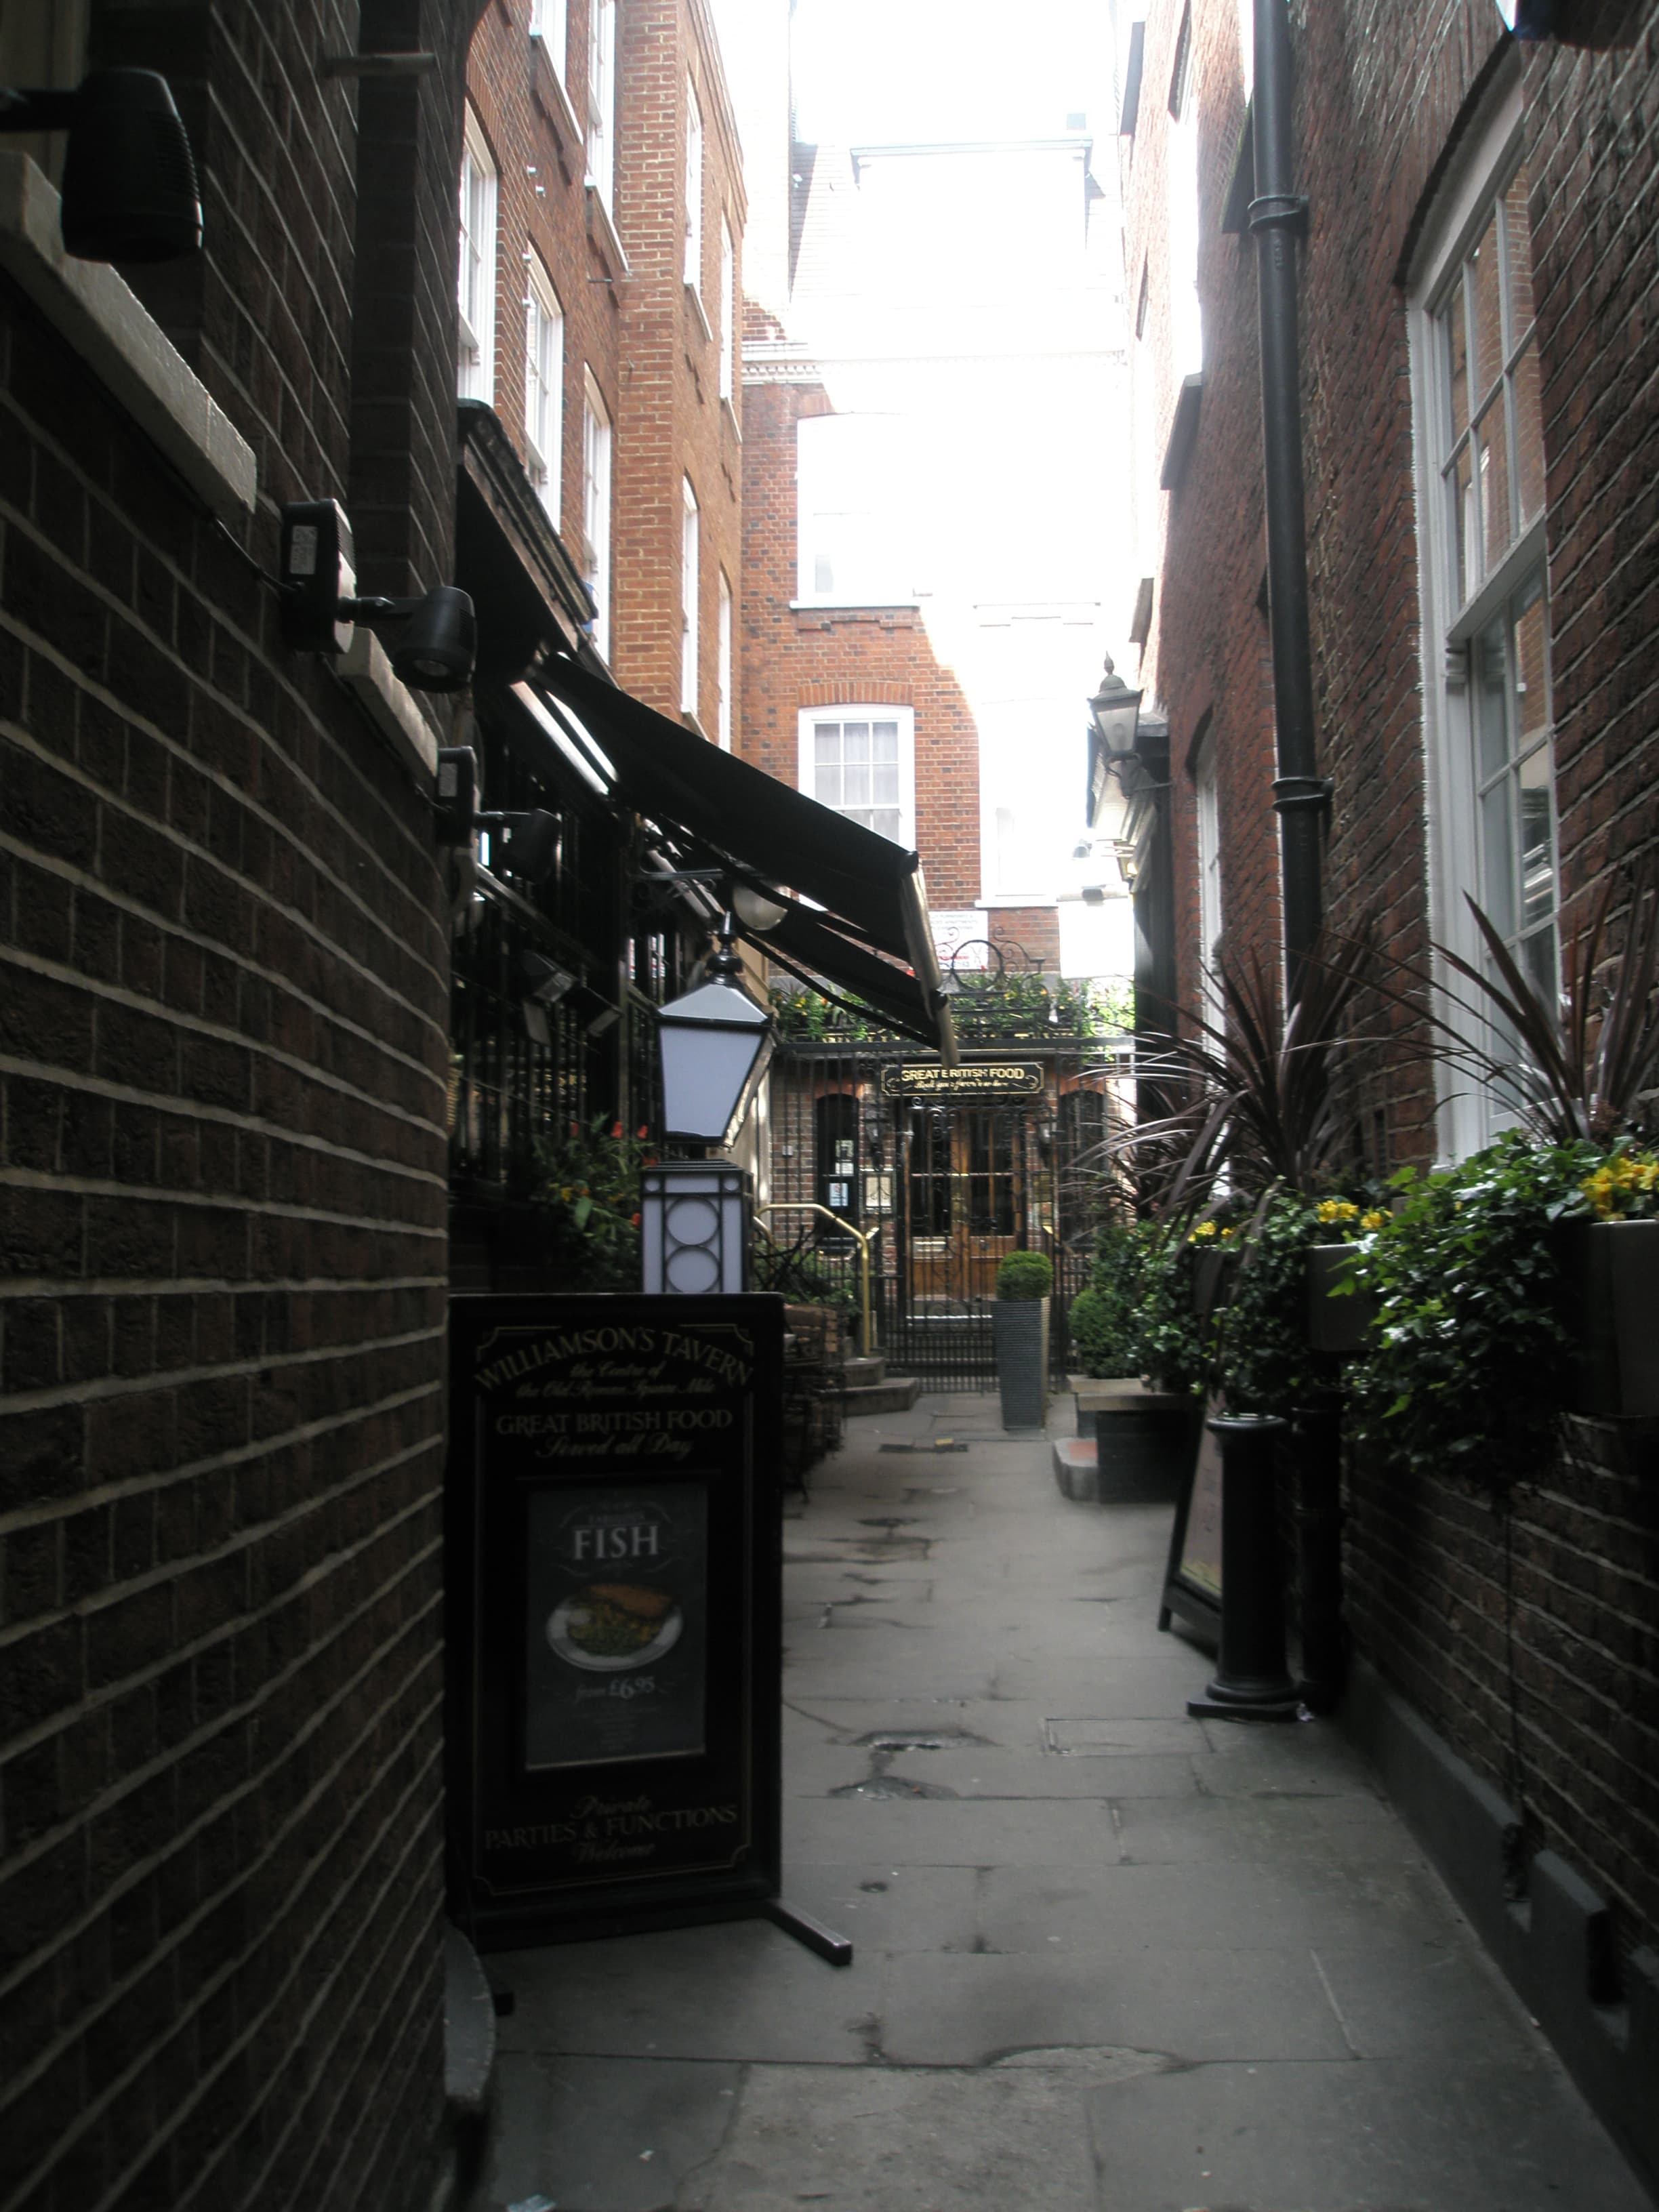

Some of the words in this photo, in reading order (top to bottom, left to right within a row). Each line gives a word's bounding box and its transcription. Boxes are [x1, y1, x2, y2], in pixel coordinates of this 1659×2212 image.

[901, 1070, 940, 1082] GREAT
[989, 1068, 1025, 1080] FOOD
[662, 1331, 754, 1387] TAVERN
[495, 1414, 571, 1437] GREAT
[576, 1411, 661, 1435] BRITISH
[666, 1409, 734, 1430] FOOD
[647, 1432, 693, 1462] Day
[573, 1525, 659, 1561] FISH
[484, 1824, 576, 1849] PARTIES
[583, 1821, 597, 1840] &
[606, 1804, 738, 1837] FUNCTIONS
